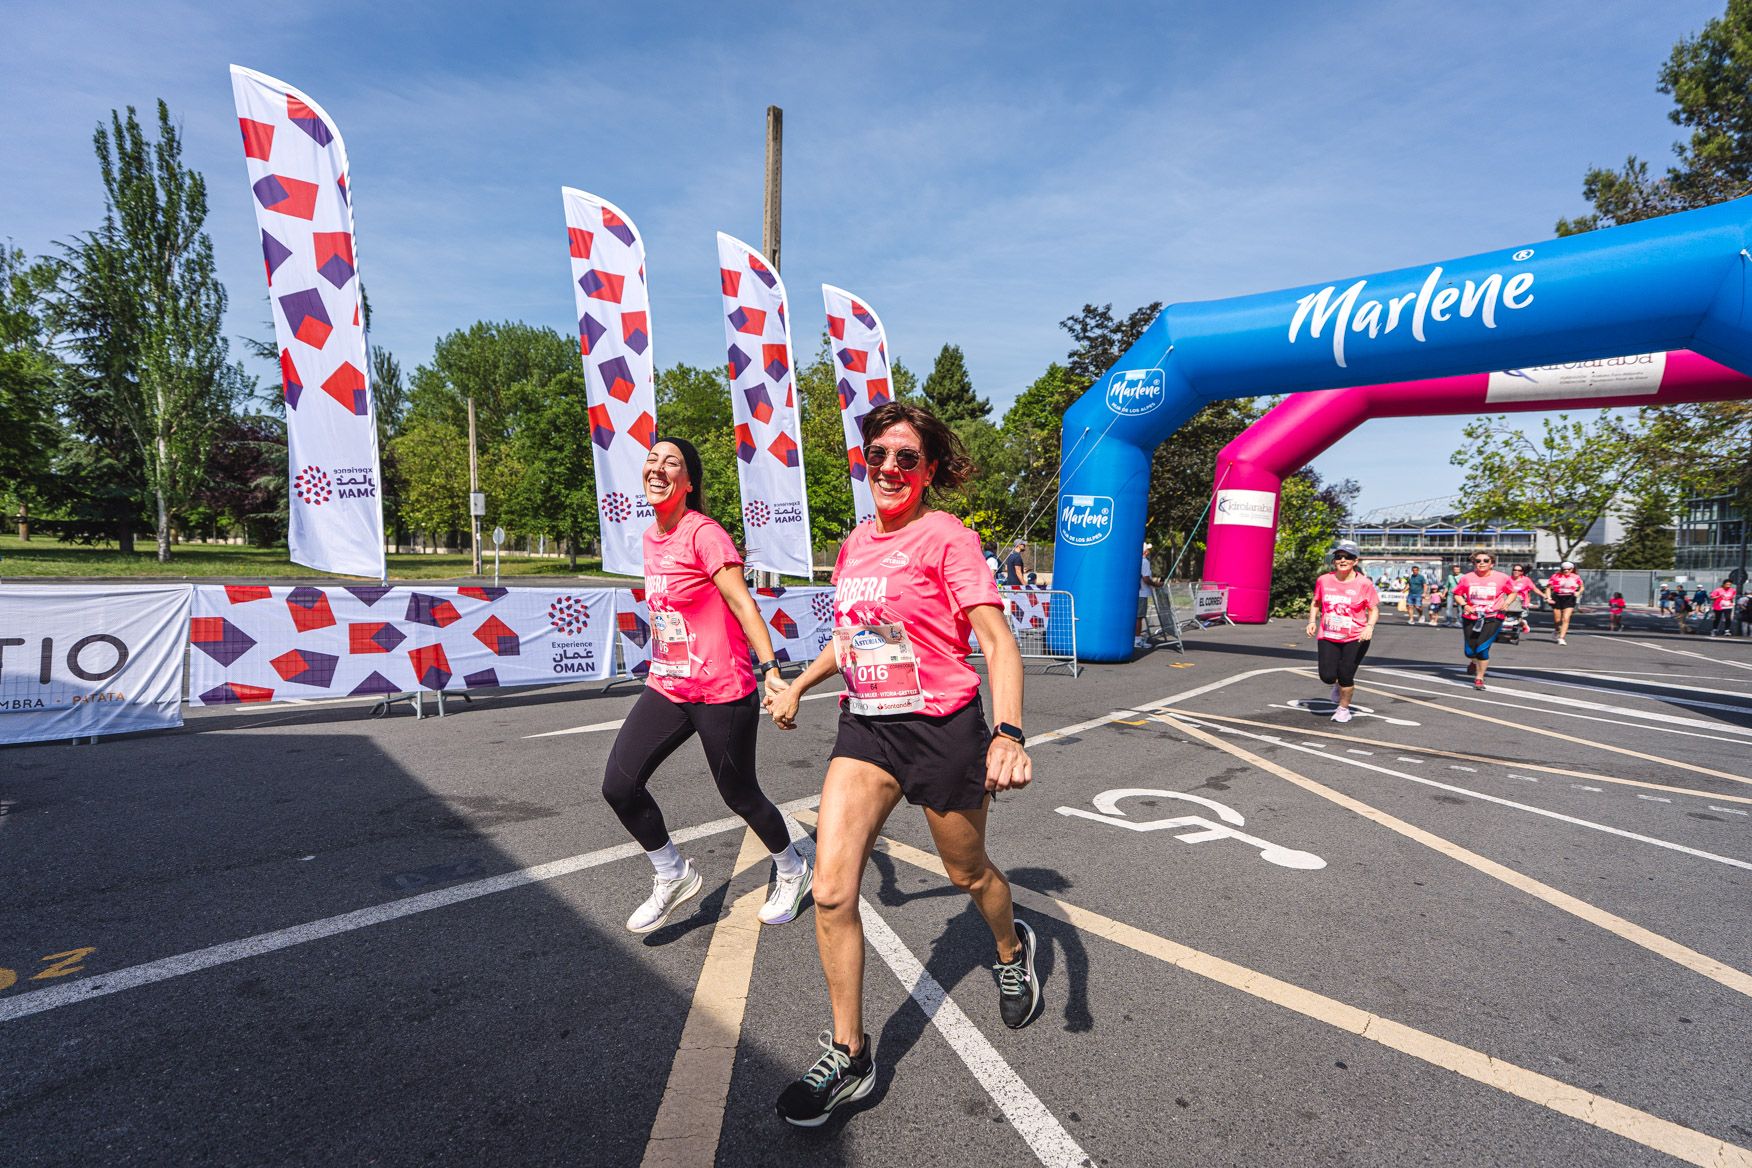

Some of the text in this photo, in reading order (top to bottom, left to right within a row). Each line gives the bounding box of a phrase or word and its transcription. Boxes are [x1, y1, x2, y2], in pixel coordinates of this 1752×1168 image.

[1288, 266, 1535, 368] Marlene
[1110, 380, 1160, 404] Marlene
[1061, 505, 1109, 531] Marlene
[551, 641, 593, 649] Experience
[553, 662, 596, 674] OMAN
[857, 664, 889, 682] 016
